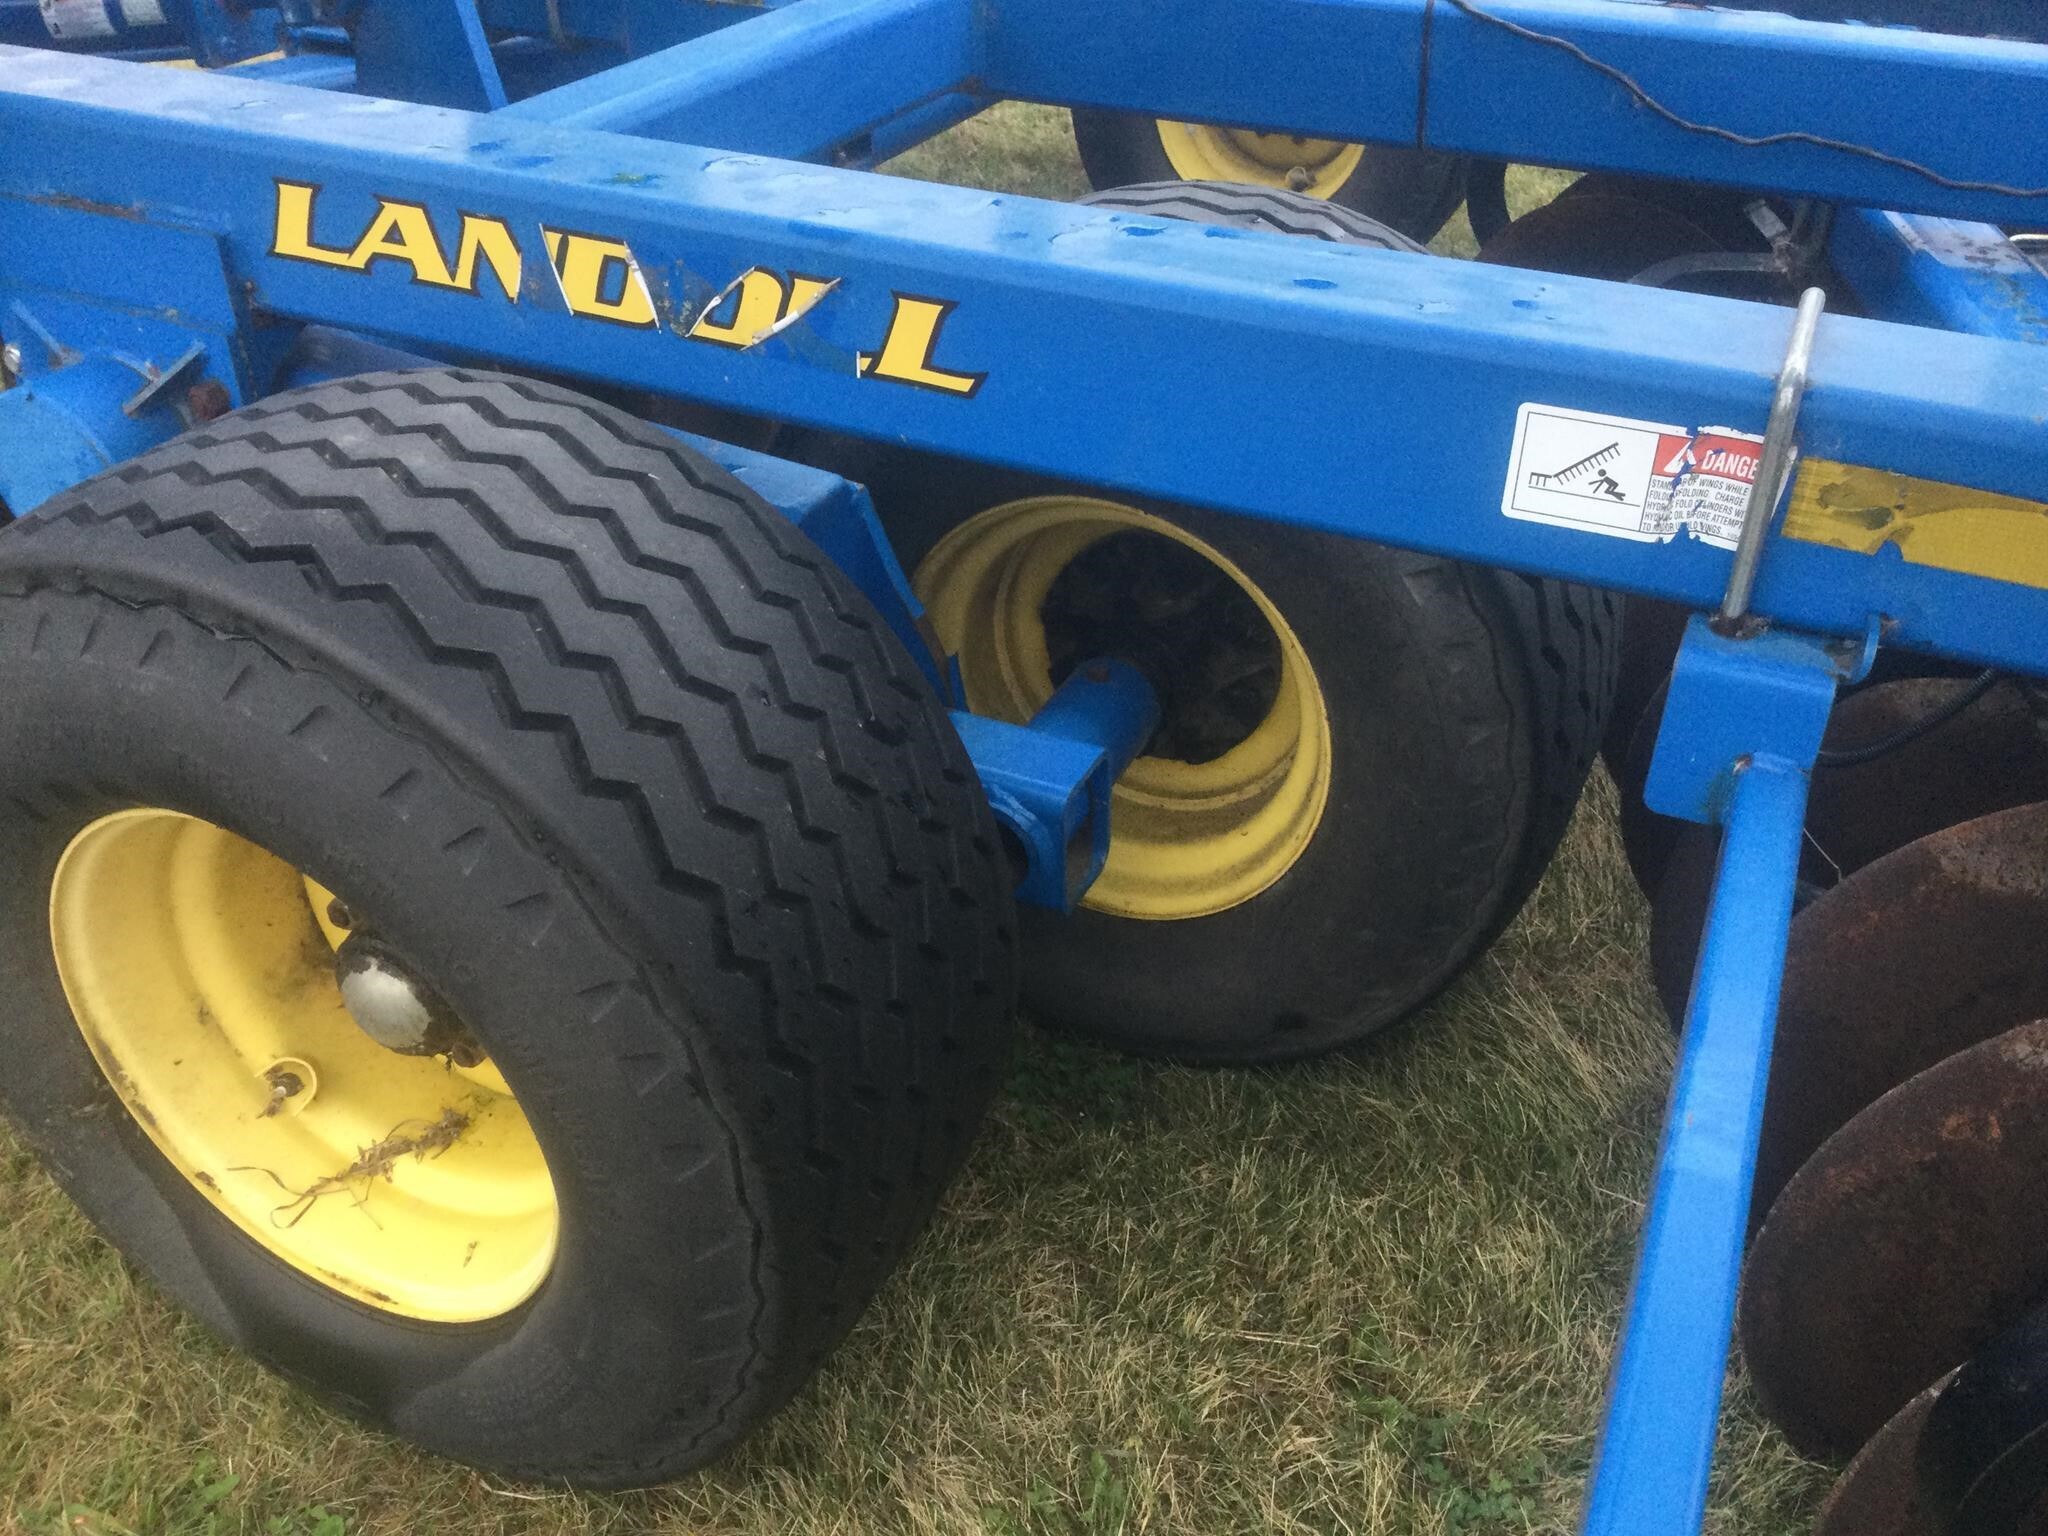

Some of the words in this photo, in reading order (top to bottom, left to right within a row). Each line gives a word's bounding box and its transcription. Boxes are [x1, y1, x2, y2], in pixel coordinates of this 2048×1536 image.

[1701, 449, 1760, 479] DANGE
[1699, 479, 1724, 490] WINGS
[1725, 482, 1749, 496] WHILE
[1714, 491, 1745, 506] CHARGE
[1643, 521, 1652, 531] TO
